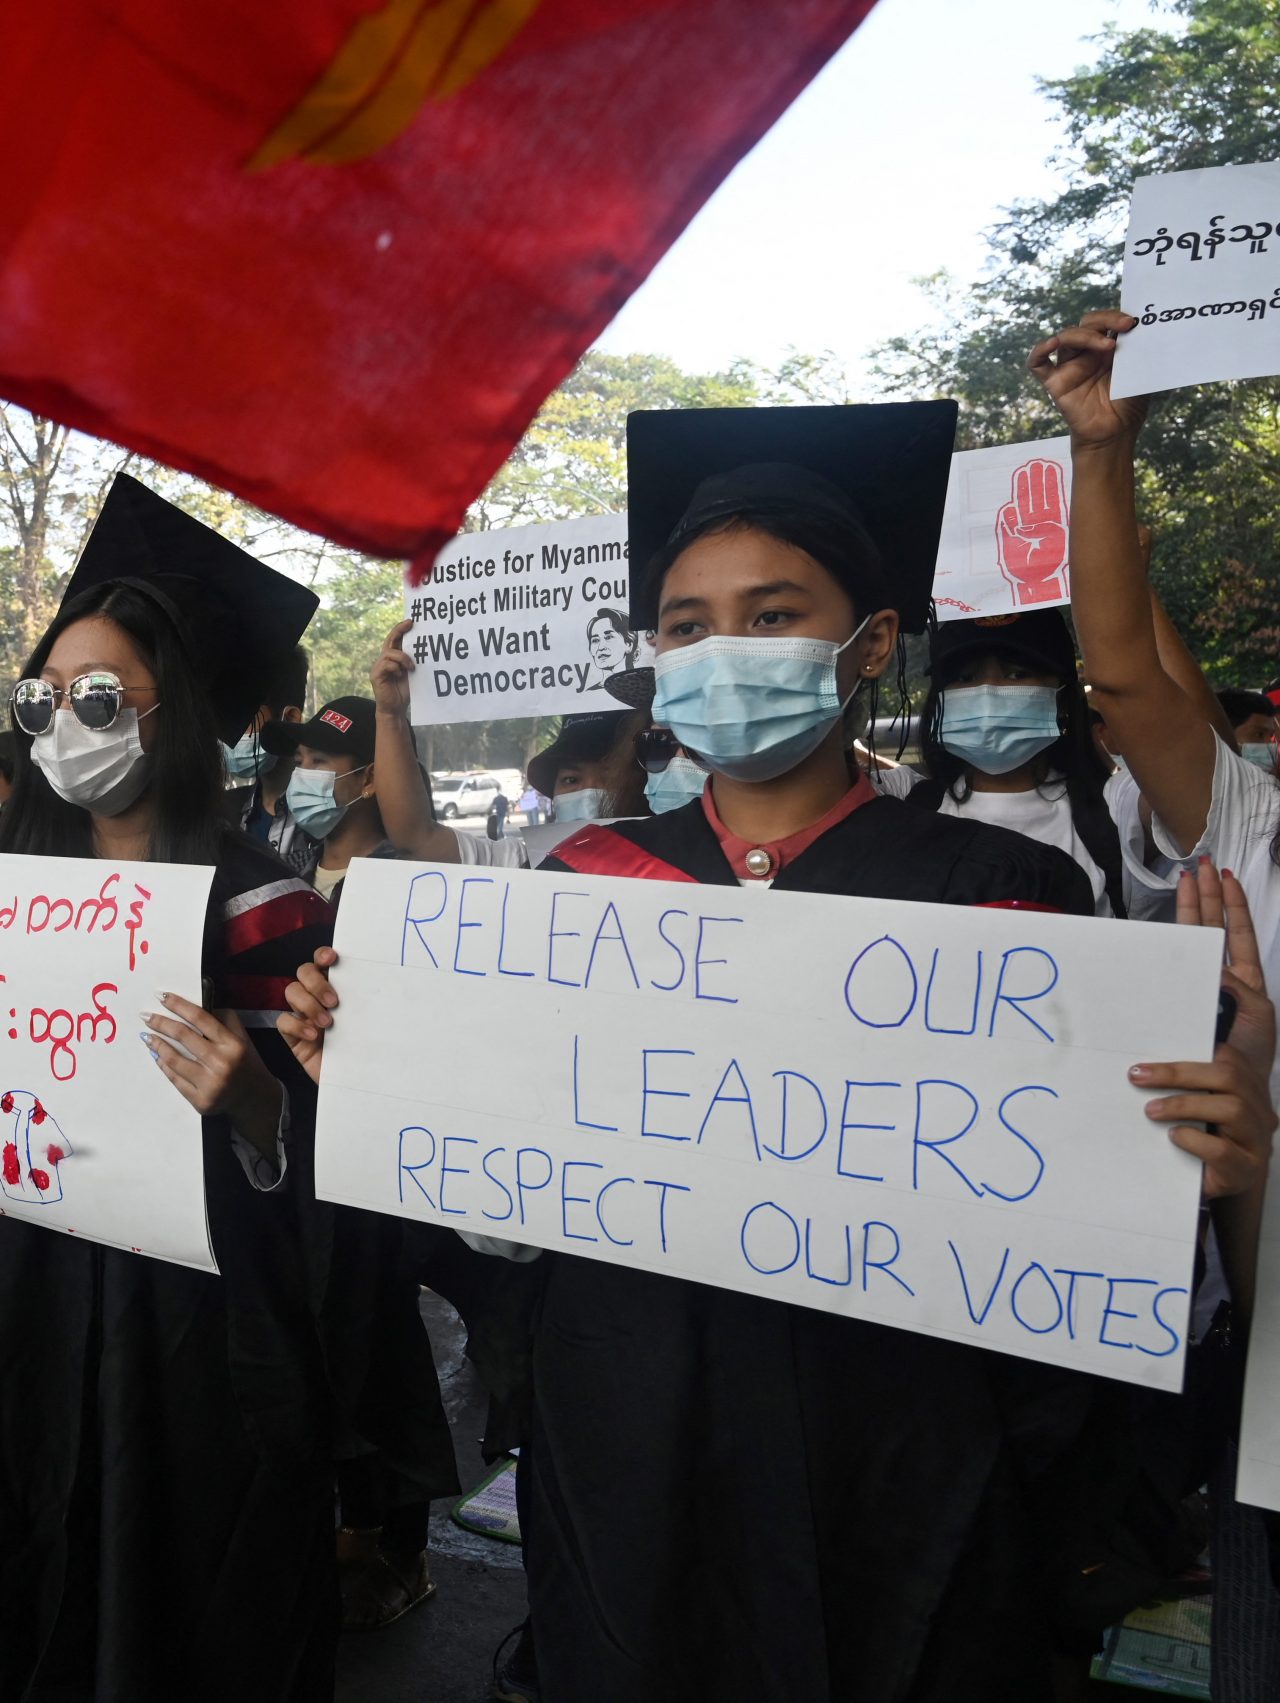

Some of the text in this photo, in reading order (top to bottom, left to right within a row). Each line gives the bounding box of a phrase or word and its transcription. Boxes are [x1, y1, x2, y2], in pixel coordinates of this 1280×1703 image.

[1132, 215, 1280, 267] ဘုံရန်သူ
[1132, 287, 1280, 326] စ်အာဏာရှ
[502, 550, 535, 575] for
[410, 591, 487, 625] #Reject
[493, 585, 574, 613] Military
[412, 622, 551, 665] #We Want
[433, 662, 591, 699] Democracy
[324, 711, 348, 729] 424
[400, 870, 1060, 1043] RELEASE OUR
[573, 1033, 1061, 1203] LEADERS
[397, 1125, 1189, 1357] RESPECT OUR VOTES
